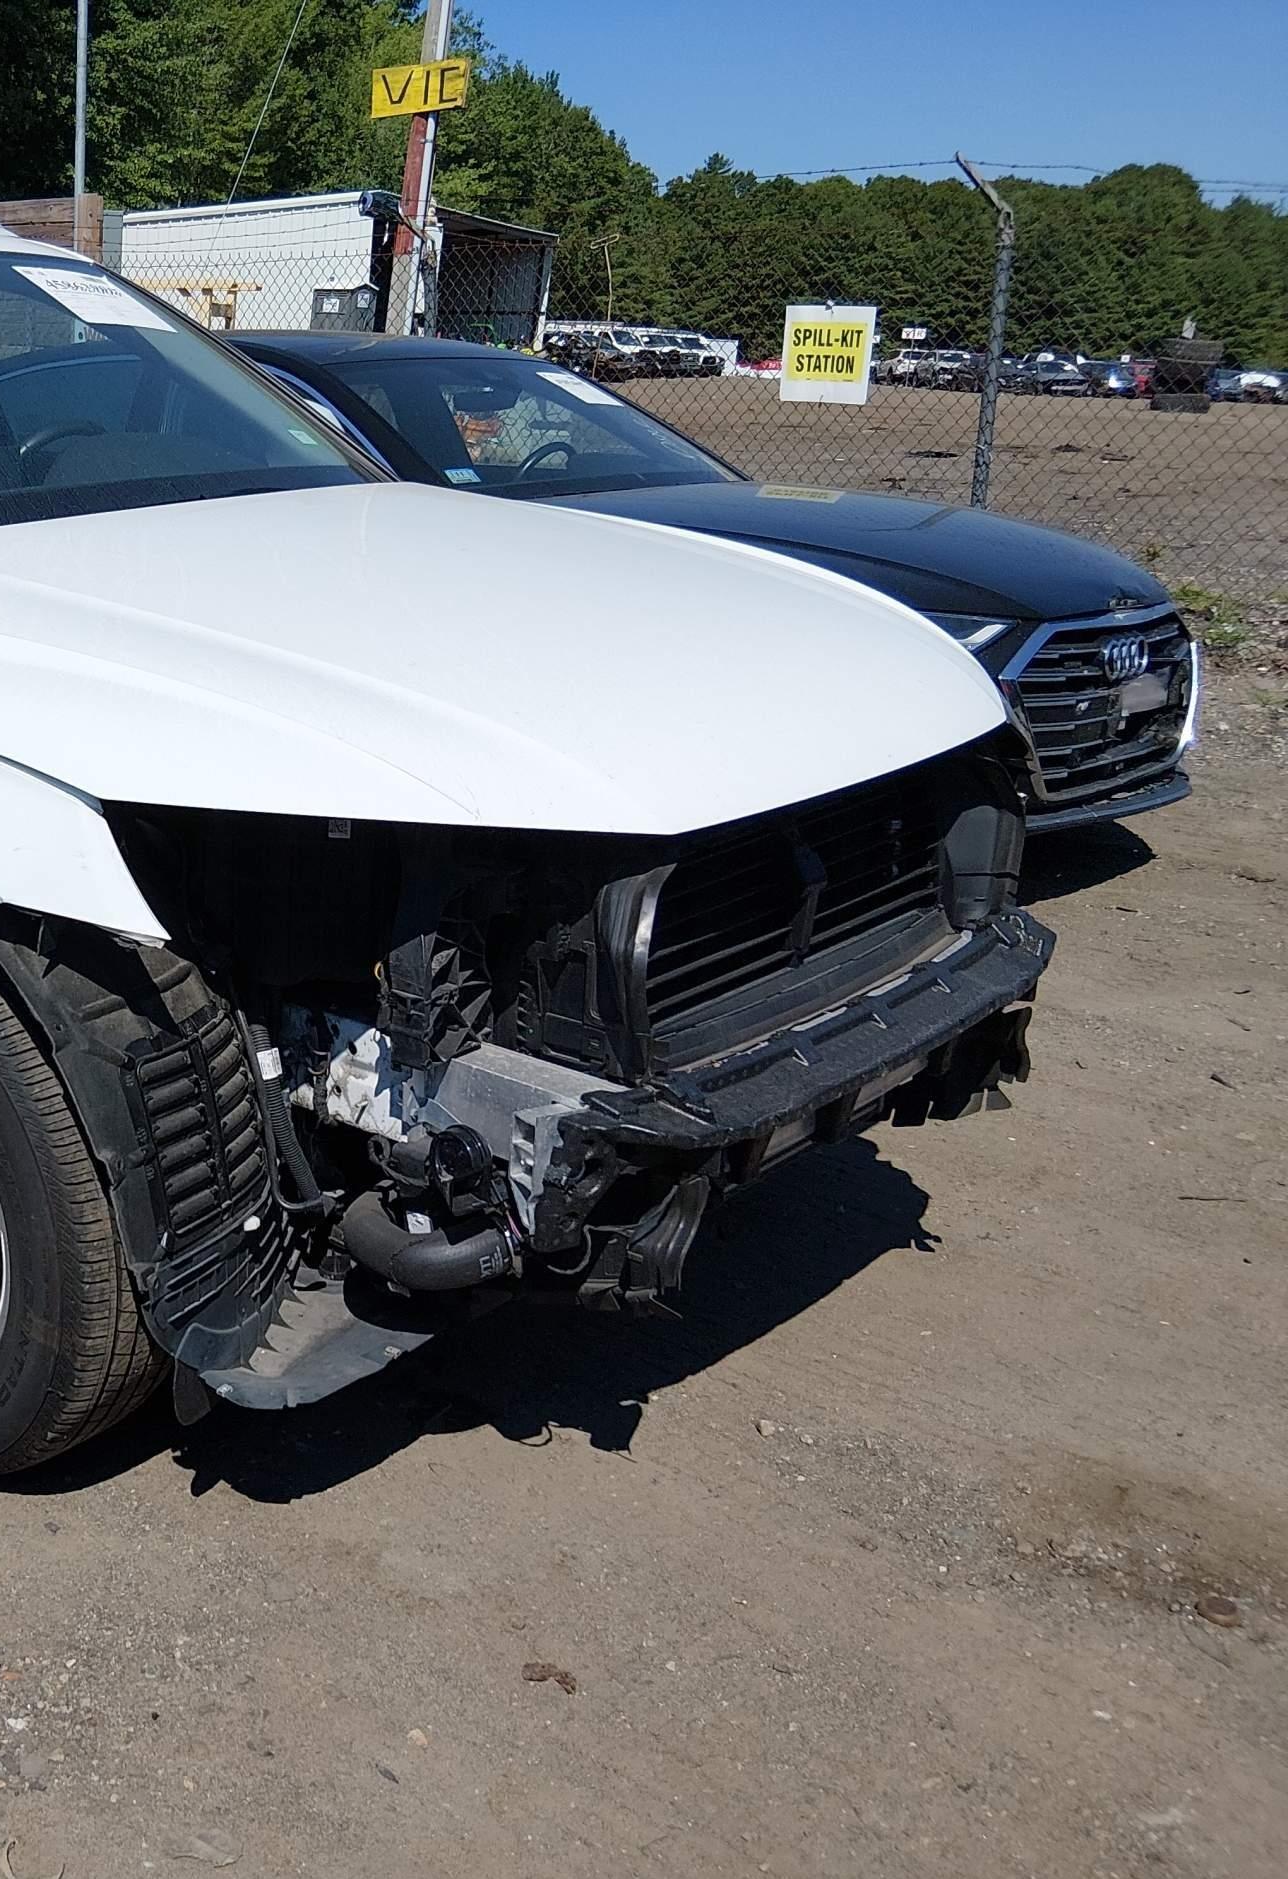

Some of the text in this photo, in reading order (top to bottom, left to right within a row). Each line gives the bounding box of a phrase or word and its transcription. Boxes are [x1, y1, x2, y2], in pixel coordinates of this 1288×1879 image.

[381, 66, 460, 106] VIC
[792, 328, 864, 349] SPILL-KIT
[795, 353, 855, 374] STATION
